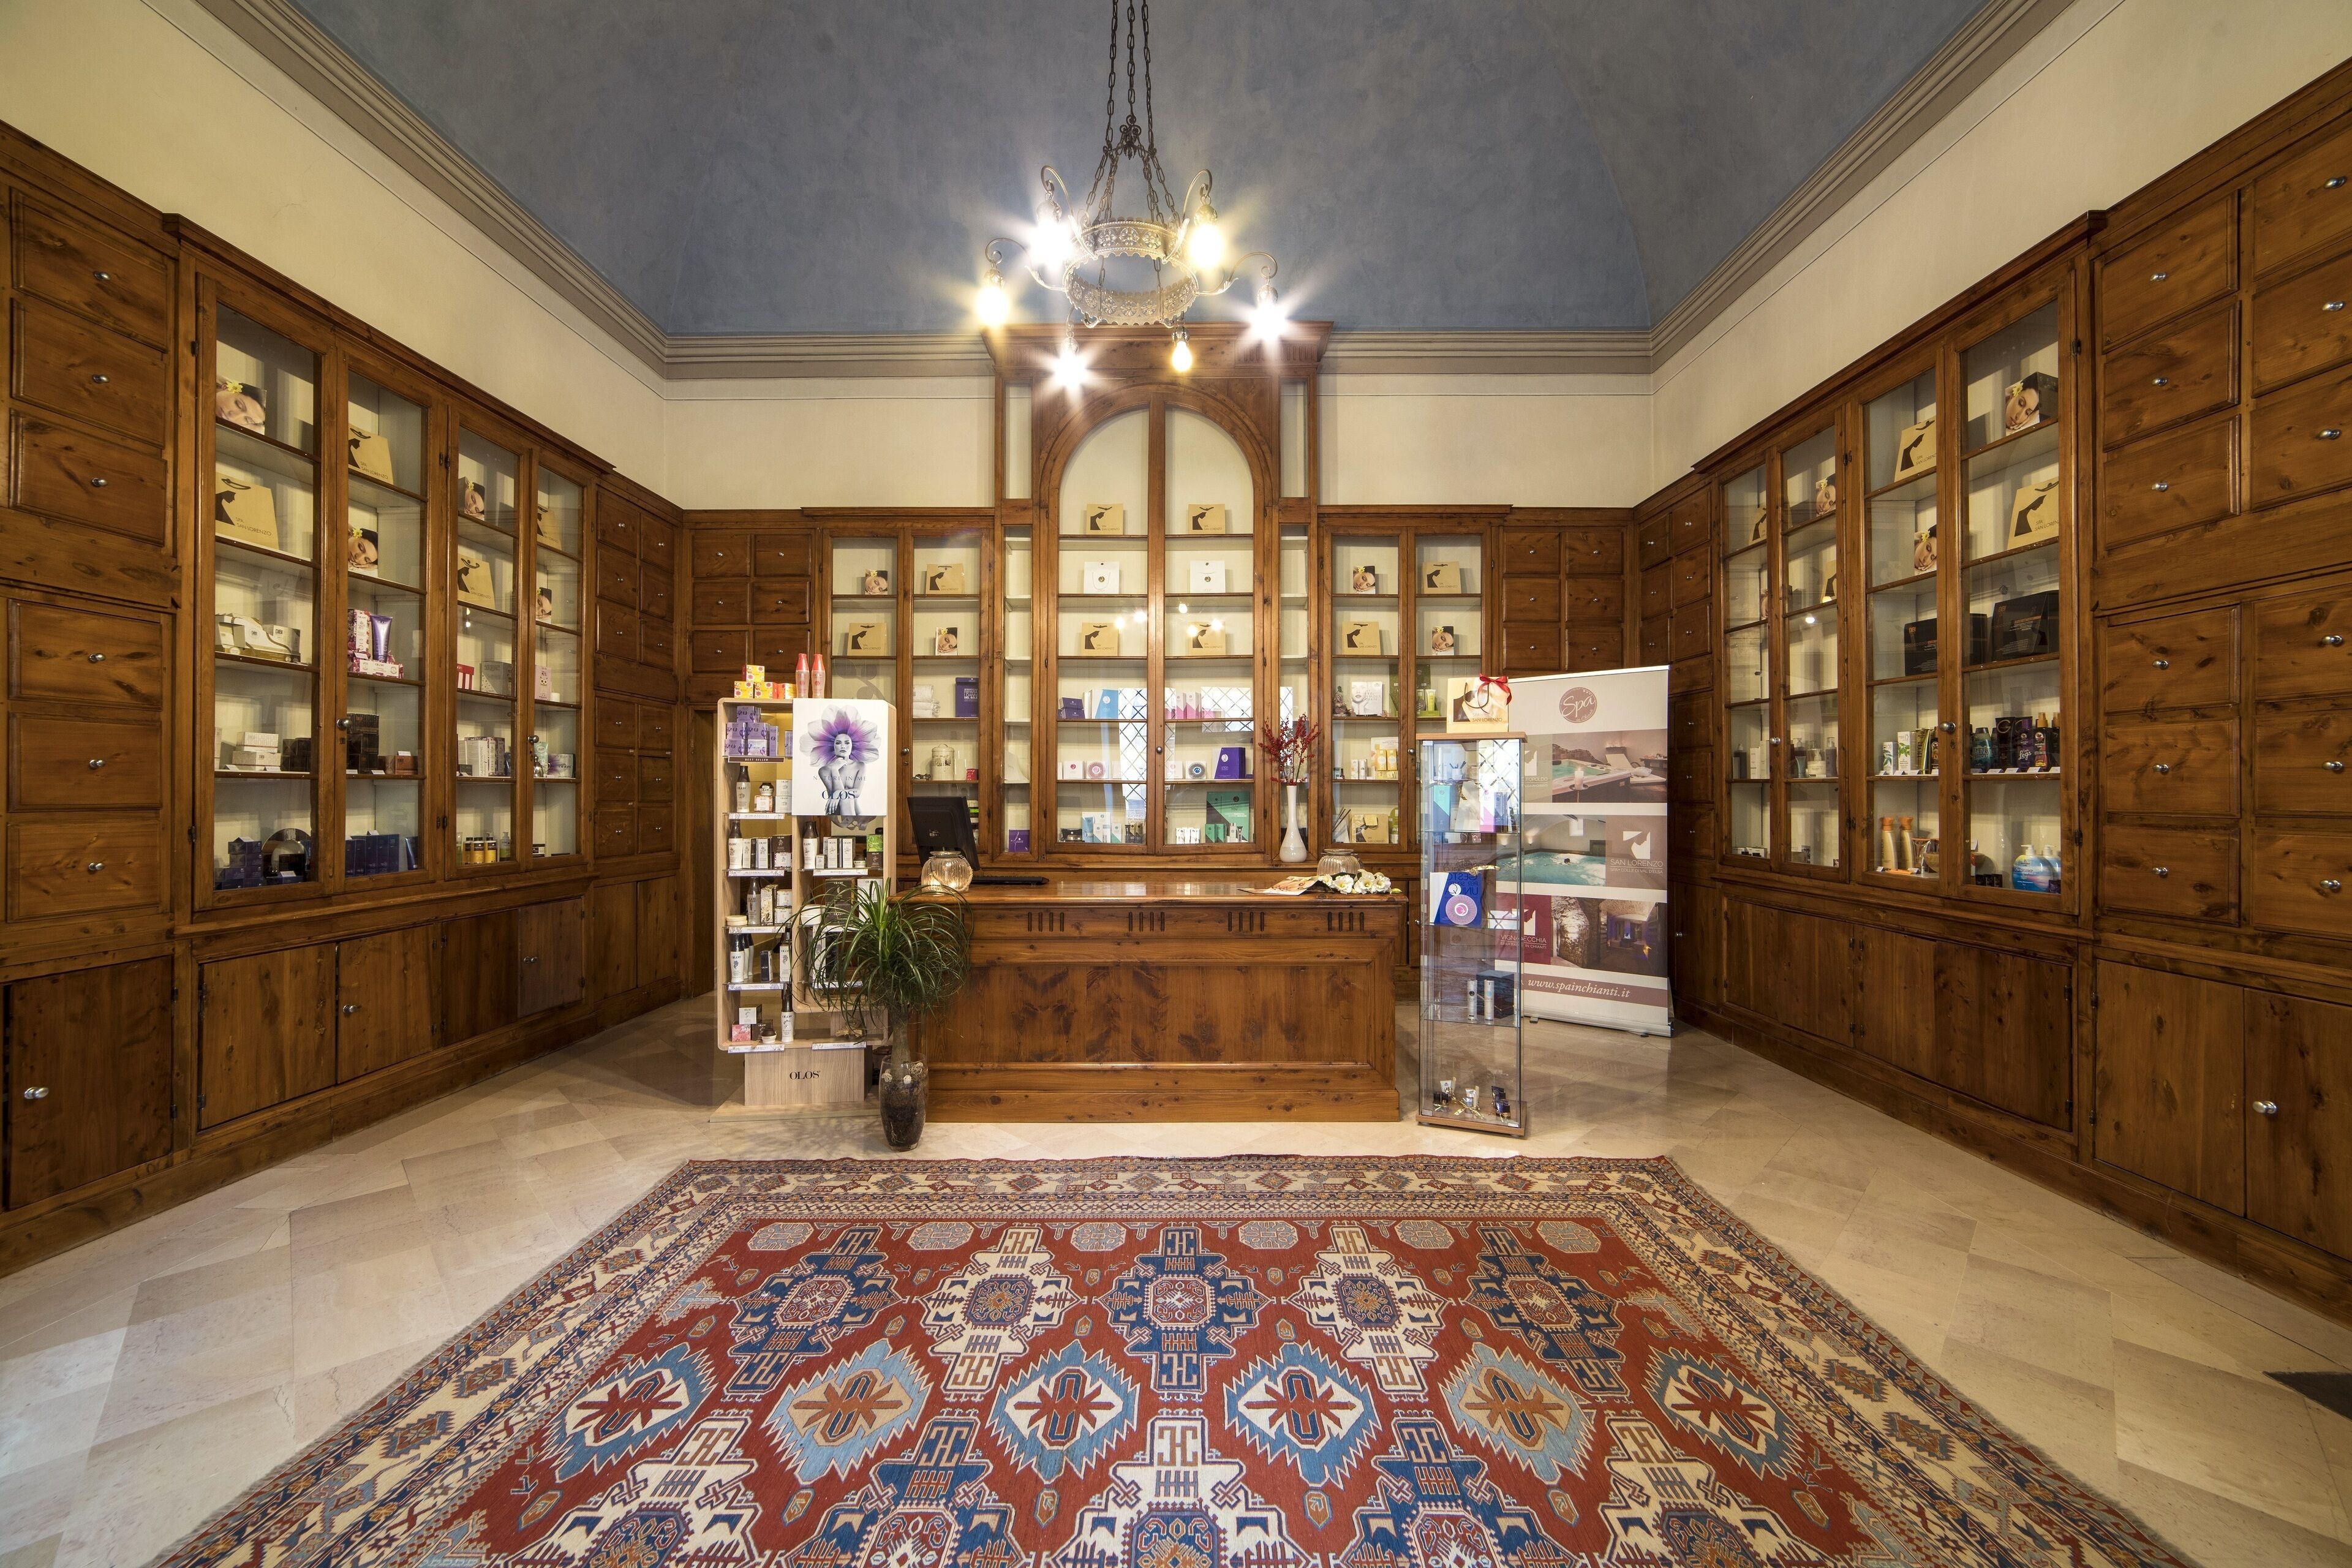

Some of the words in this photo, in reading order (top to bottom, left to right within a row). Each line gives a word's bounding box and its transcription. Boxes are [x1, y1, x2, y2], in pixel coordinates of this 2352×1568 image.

[247, 526, 272, 537] LORENZO
[1561, 695, 1596, 718] Spa
[2018, 750, 2032, 761] Legs
[1528, 979, 1630, 998] www.spainchianti.it
